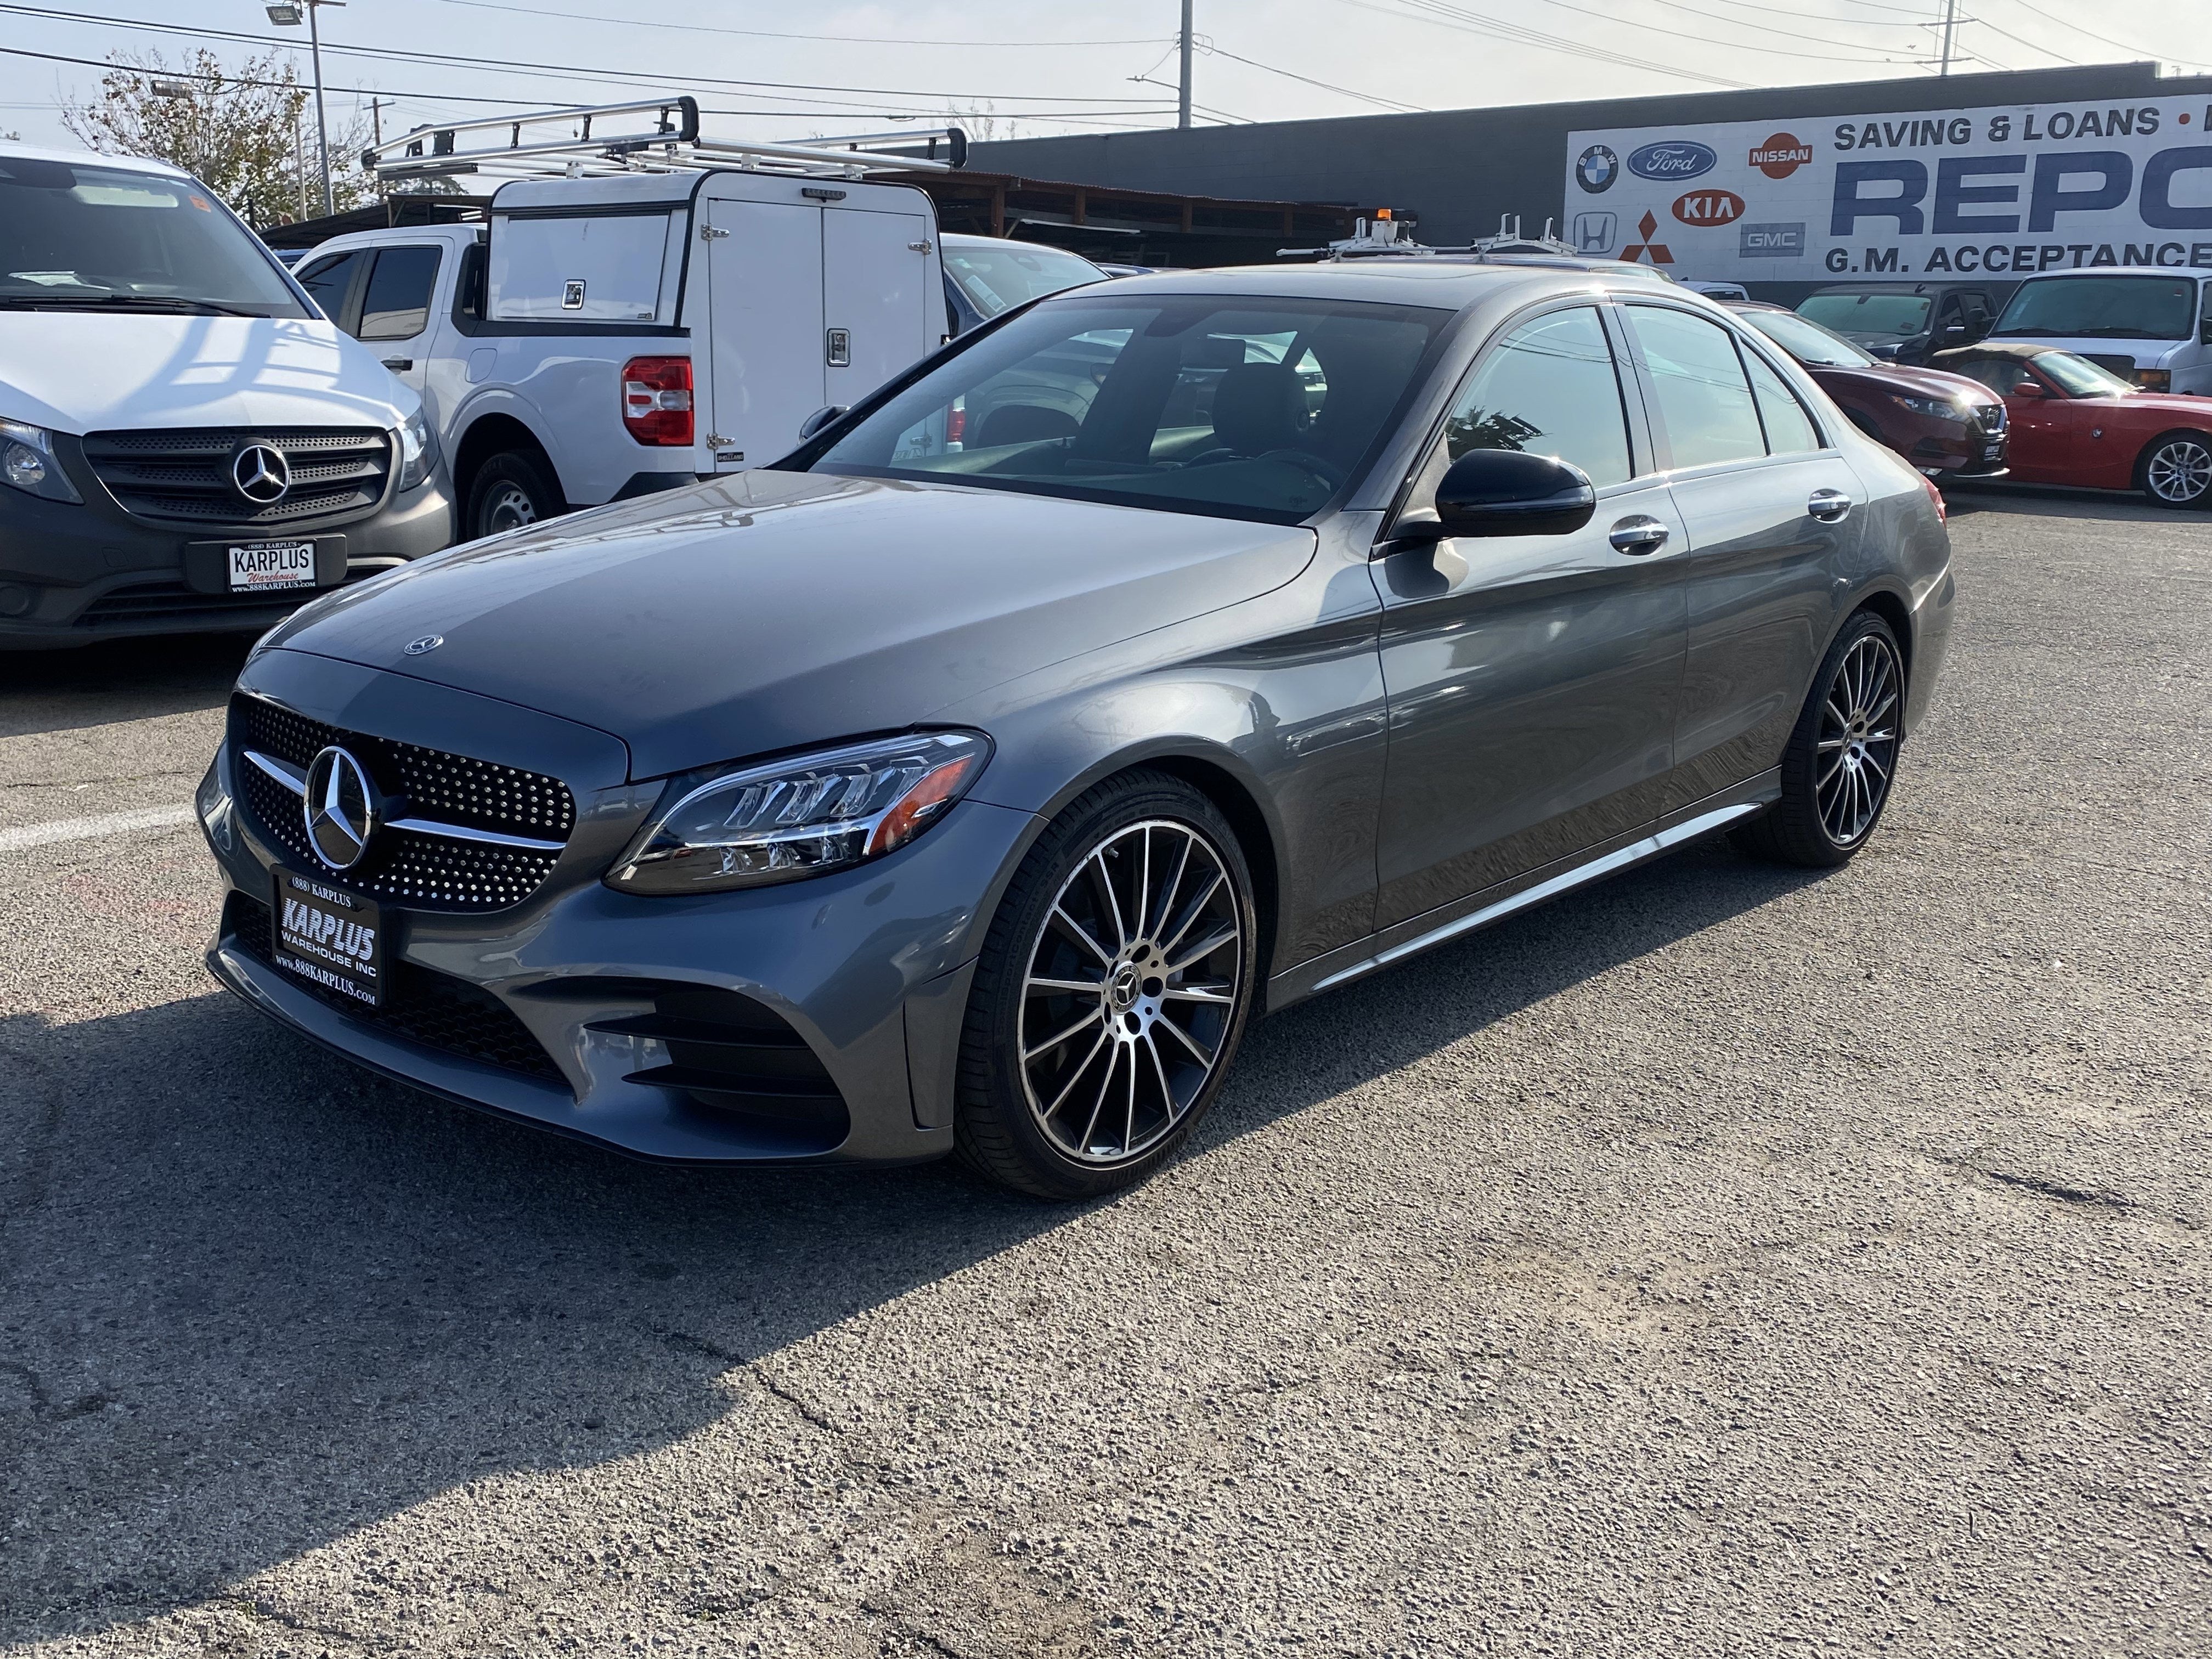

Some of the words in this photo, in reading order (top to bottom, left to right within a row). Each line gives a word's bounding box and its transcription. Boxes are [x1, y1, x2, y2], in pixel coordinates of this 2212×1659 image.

[1834, 118, 1971, 150] SAVING
[1988, 116, 2011, 142] &
[2023, 107, 2160, 140] LOANS
[1578, 146, 1617, 167] BMW
[1646, 149, 1697, 171] Ford
[1752, 149, 1809, 163] NISSAN
[1683, 196, 1735, 218] KIA
[1747, 232, 1797, 247] GMC
[1825, 247, 1909, 273] G.M.
[1924, 242, 2212, 272] ACCEPTANCE
[234, 549, 309, 573] KARPLUS
[247, 570, 299, 583] Warehouse
[292, 876, 310, 893] (888)
[312, 883, 351, 908] KARPLUS
[281, 897, 375, 961] KARPLUS
[281, 930, 352, 968] WAREHOUSE
[356, 961, 377, 978] INC
